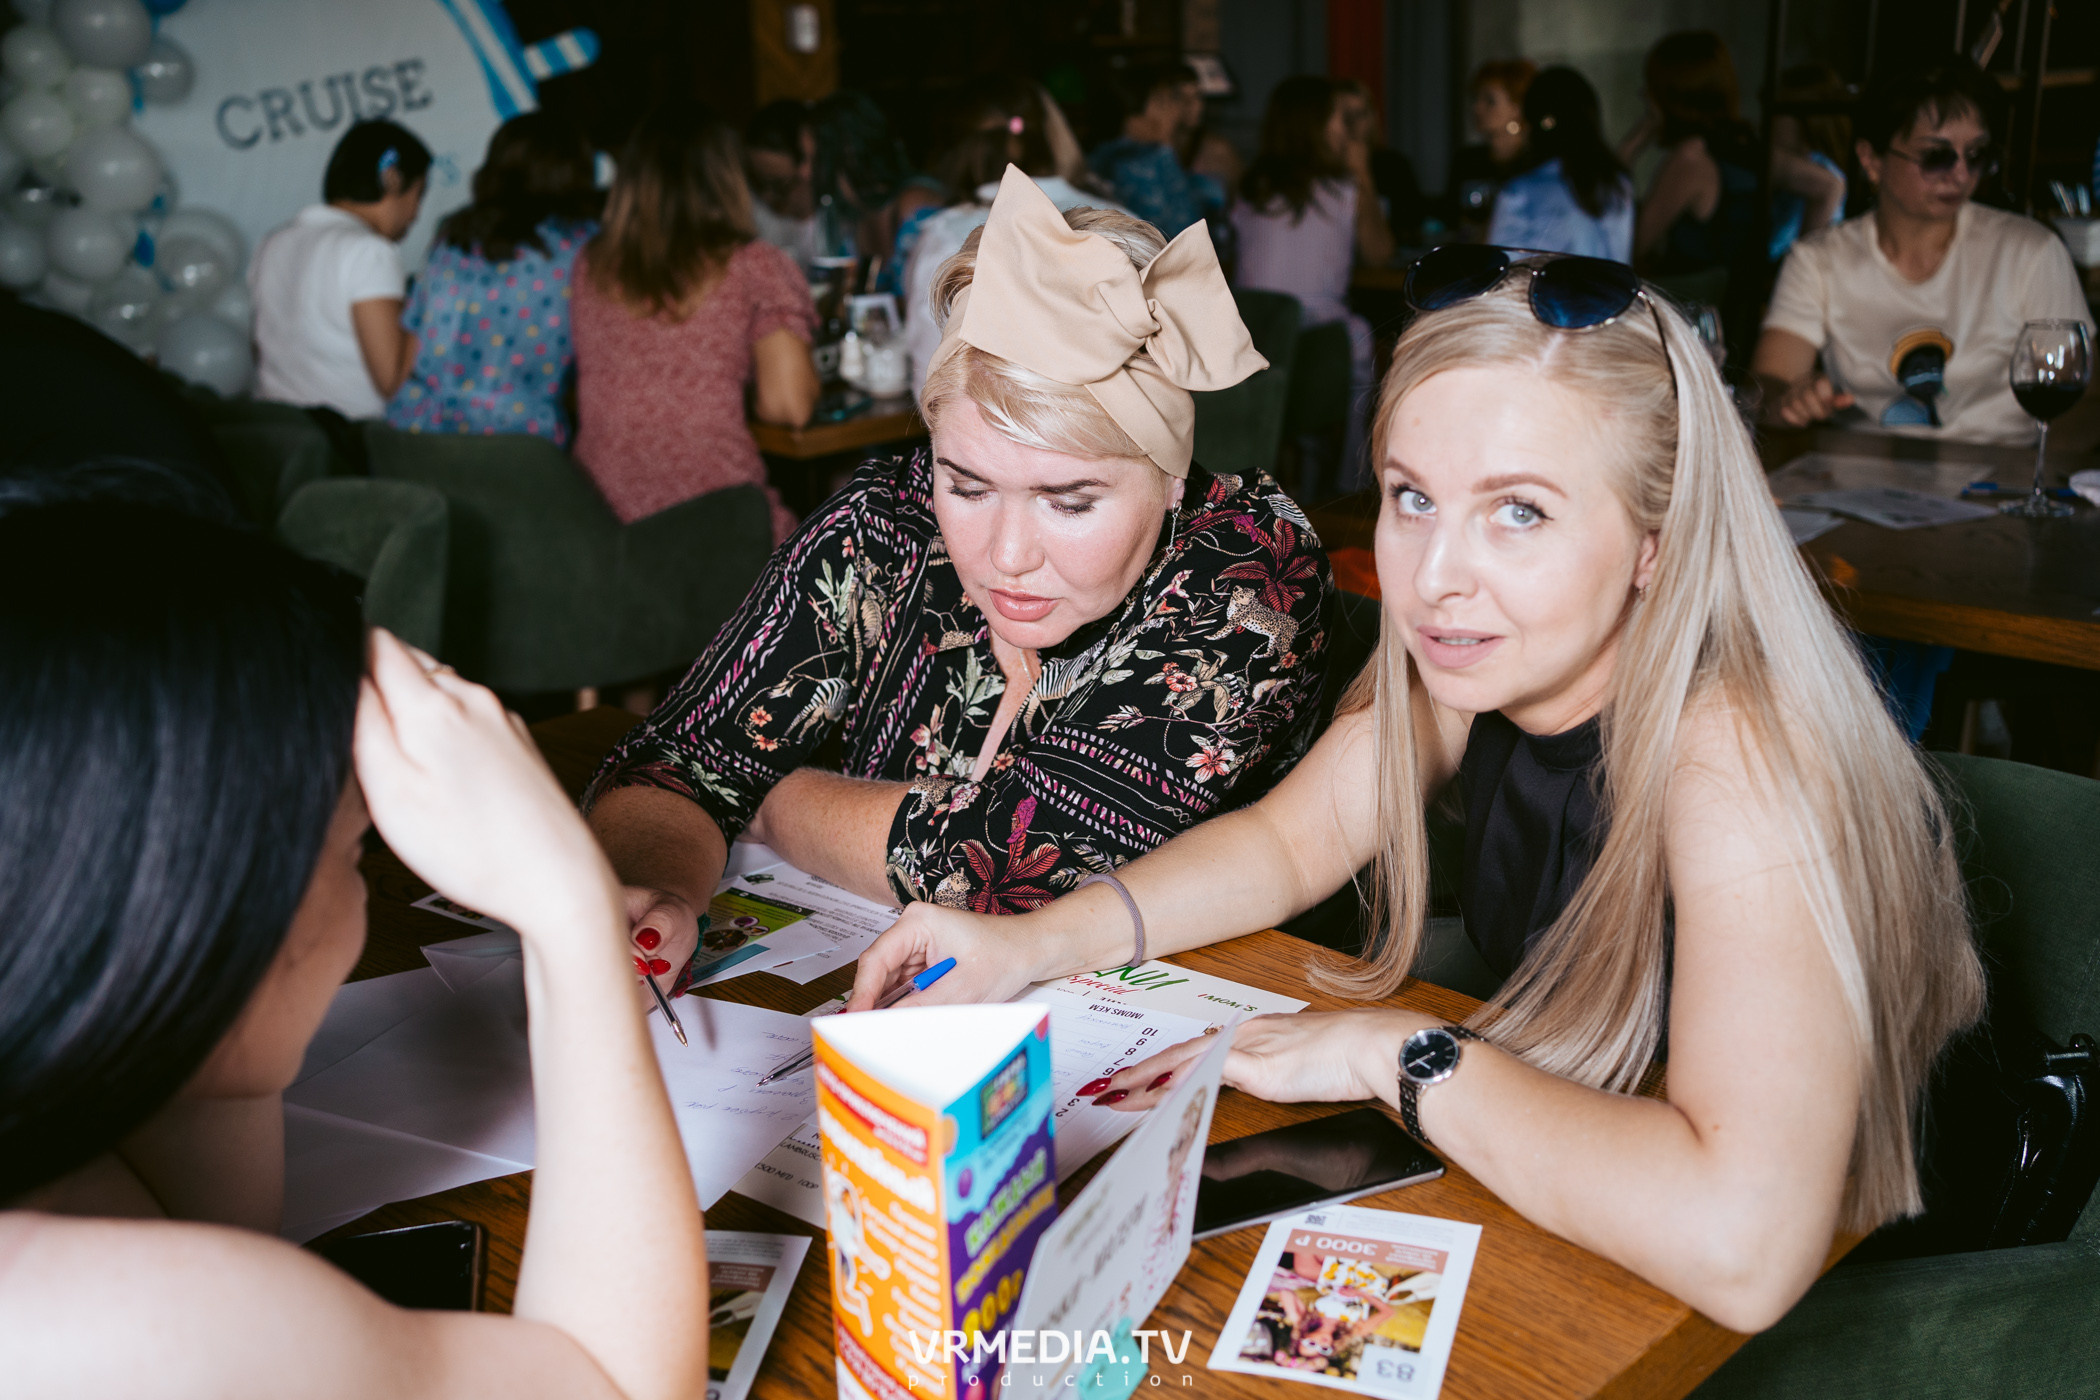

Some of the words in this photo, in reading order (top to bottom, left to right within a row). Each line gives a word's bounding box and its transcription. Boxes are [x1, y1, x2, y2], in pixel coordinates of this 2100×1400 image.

[215, 57, 432, 150] CRUISE
[1089, 1003, 1144, 1020] IMOMS.KEM
[1141, 1027, 1158, 1037] 10
[1136, 1038, 1147, 1046] 9
[1125, 1047, 1136, 1056] 8
[1113, 1057, 1125, 1066] 7
[1102, 1067, 1115, 1076] 6
[1067, 1098, 1079, 1107] 3
[1055, 1108, 1068, 1117] 2
[780, 1141, 822, 1161] LAMBRUSC
[1316, 1237, 1379, 1257] 3000
[1376, 1358, 1416, 1383] 83
